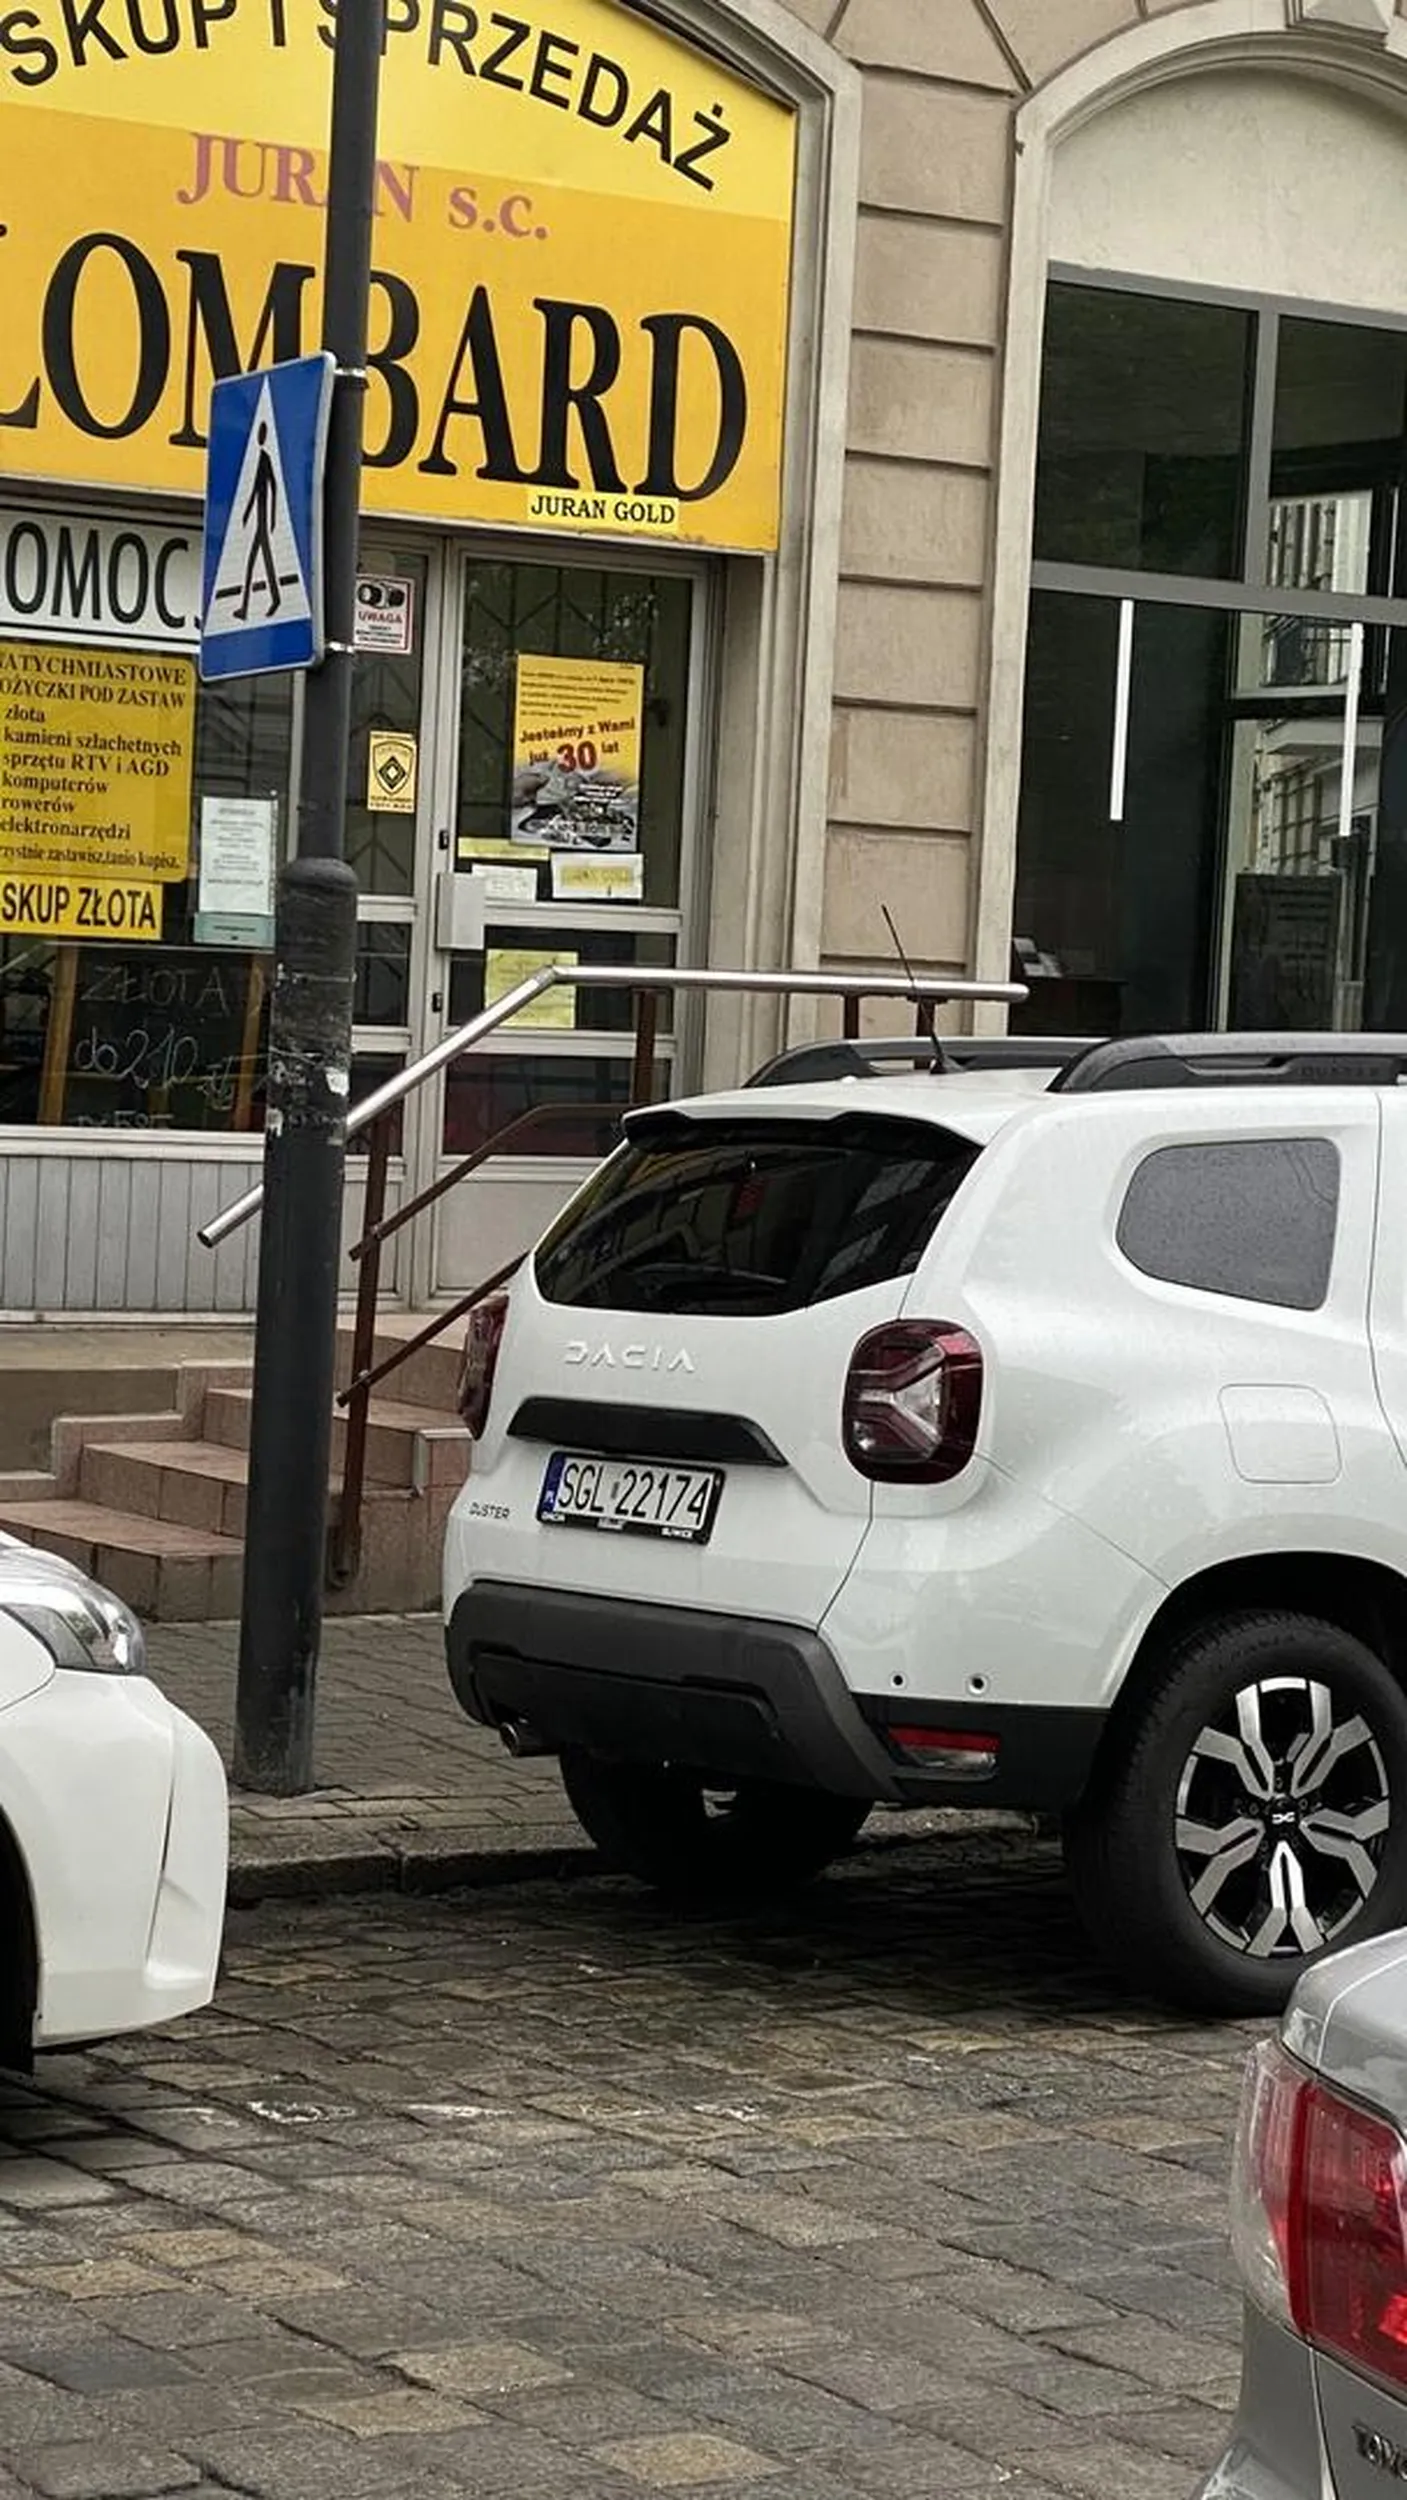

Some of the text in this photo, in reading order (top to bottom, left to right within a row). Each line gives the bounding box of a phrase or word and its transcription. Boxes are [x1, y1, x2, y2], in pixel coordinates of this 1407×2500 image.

[0, 0, 237, 86] SKUP
[176, 131, 420, 223] JURN
[0, 224, 748, 501] OMBARD
[531, 495, 675, 524] JURAN GOLD
[5, 520, 202, 630] OMOC
[0, 654, 186, 686] ATYCHMIASTOWE
[80, 685, 113, 704] POD
[117, 687, 186, 709] ZASTAW
[5, 704, 45, 723] złota
[4, 727, 181, 757] kamieni szlachetnych
[520, 717, 636, 743] Jesteśmy z Wami
[4, 752, 169, 777] sprzętu RTV i AGD
[529, 741, 620, 774] już 30 lat
[3, 770, 108, 794] komputerów
[2, 796, 74, 813] rowerów
[0, 816, 131, 842] elektronarzędzi
[2, 882, 157, 929] SKUP ZŁOTA
[563, 1340, 698, 1374] DACIA
[557, 1462, 710, 1528] SGL 22174
[469, 1501, 511, 1520] DUSTER
